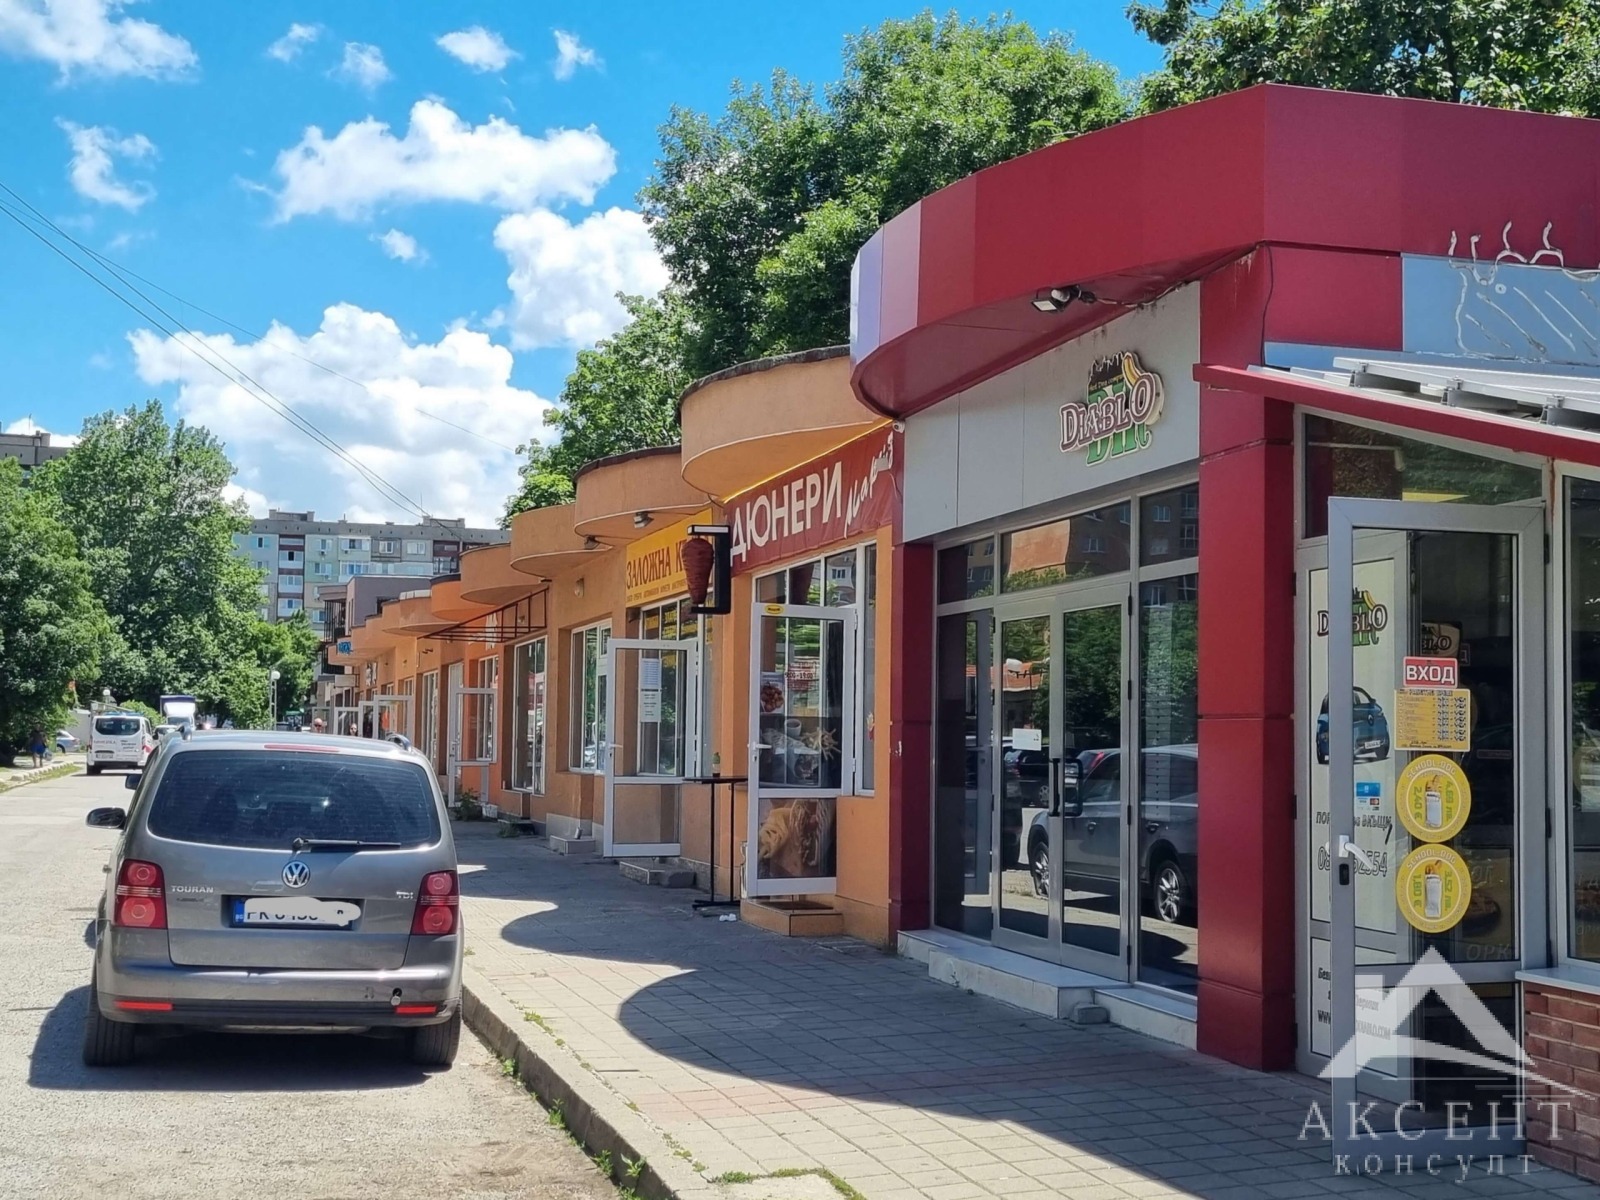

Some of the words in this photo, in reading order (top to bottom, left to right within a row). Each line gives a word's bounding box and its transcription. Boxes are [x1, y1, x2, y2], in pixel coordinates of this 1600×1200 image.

[730, 461, 842, 566] ДЮНЕРИ
[626, 546, 672, 589] ЗАЛОЖНА
[1406, 665, 1455, 684] ВХОД
[171, 885, 214, 893] TOURAN
[396, 891, 414, 899] TDI
